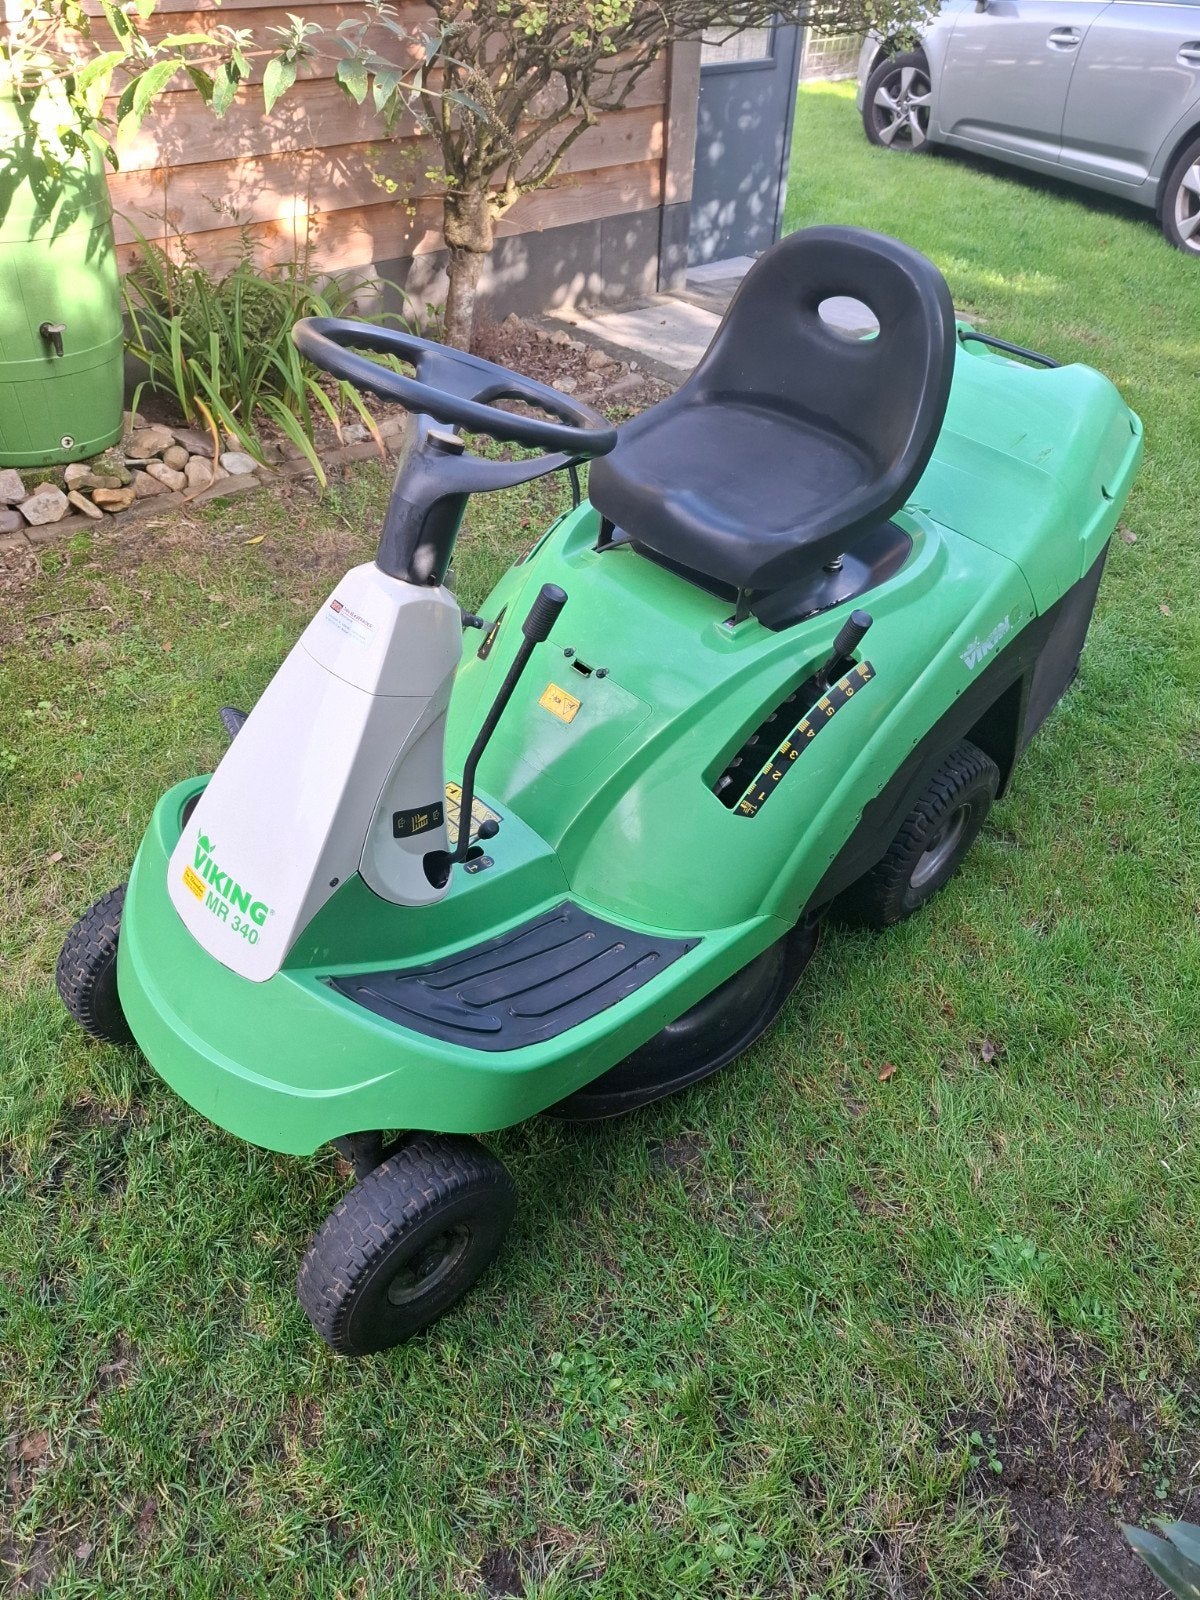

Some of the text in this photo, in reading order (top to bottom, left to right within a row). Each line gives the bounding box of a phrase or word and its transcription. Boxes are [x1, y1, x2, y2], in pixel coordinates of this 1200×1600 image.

[863, 674, 872, 682] 7
[845, 687, 854, 697] 6
[825, 706, 835, 716] 5
[806, 729, 815, 737] 4
[789, 750, 799, 760] 3
[772, 770, 782, 780] 2
[758, 791, 765, 800] 1
[194, 844, 269, 927] VIKING
[205, 890, 259, 945] MR 340
